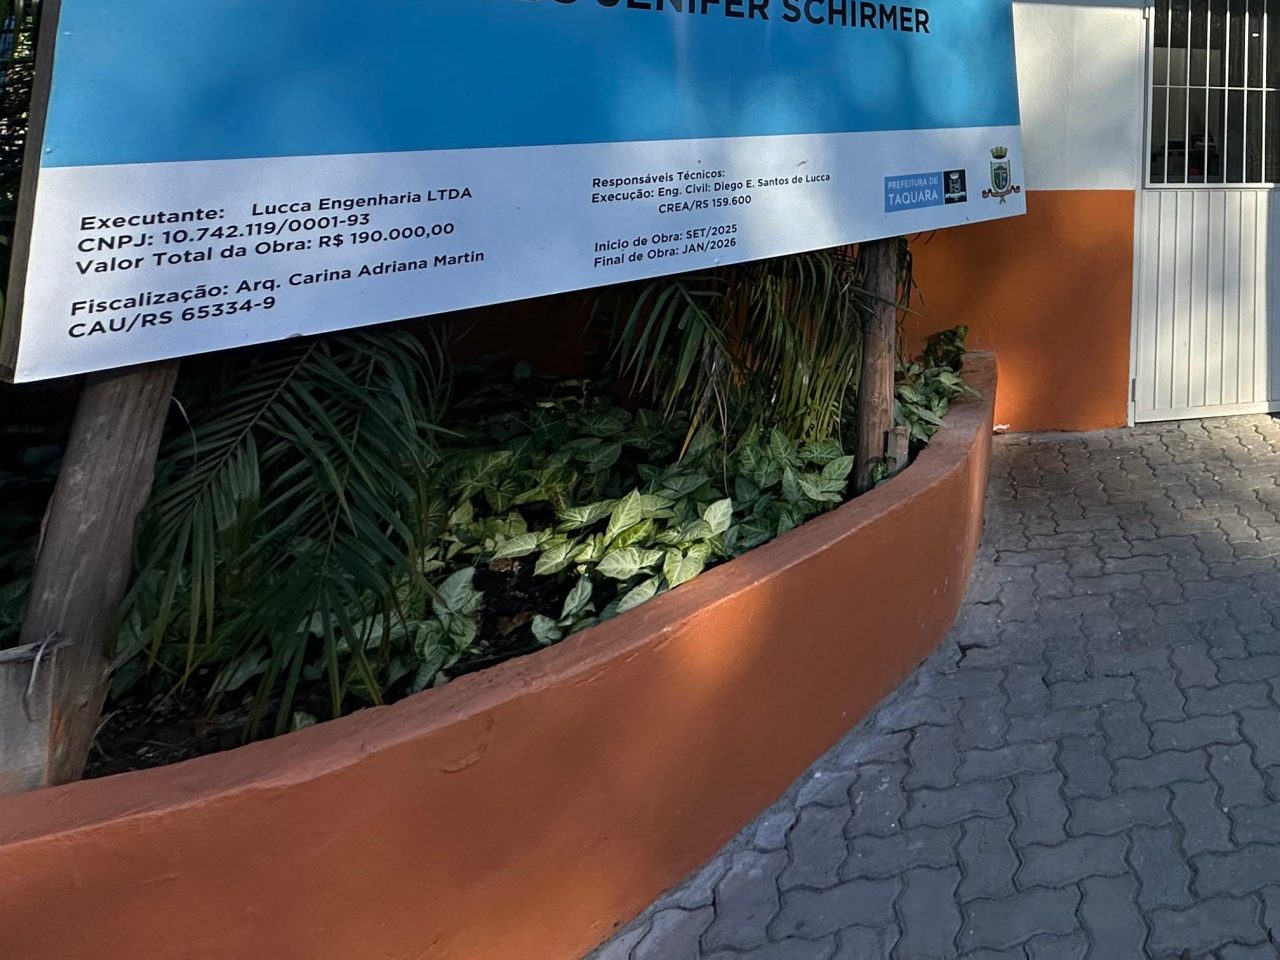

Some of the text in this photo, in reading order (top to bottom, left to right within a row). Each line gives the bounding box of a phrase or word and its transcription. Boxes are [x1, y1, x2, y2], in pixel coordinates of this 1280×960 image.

[591, 172, 831, 204] Execução: Eng. Civil: Diego E. Santos de Lucca
[592, 168, 726, 189] Responsáveis Técnicos:
[887, 176, 938, 190] PREFEITURA DE
[80, 187, 472, 231] Executante: Lucca Engenharia LTDA
[658, 194, 752, 214] CREA/RS 159.600
[888, 189, 939, 207] TAQUARA
[77, 213, 370, 253] CNPJ: 10.742.119/0001-93
[633, 236, 648, 247] de
[651, 231, 683, 245] Obra:
[686, 223, 738, 240] SET/2025
[76, 223, 455, 275] Valor Total da Obra: R$ 190.000,00
[593, 237, 737, 268] Final de Obra: JAN/2026
[71, 251, 485, 317] Fiscalização: Arq. Carina Adriana Martin
[68, 296, 276, 339] CAU/RS 65334-9
